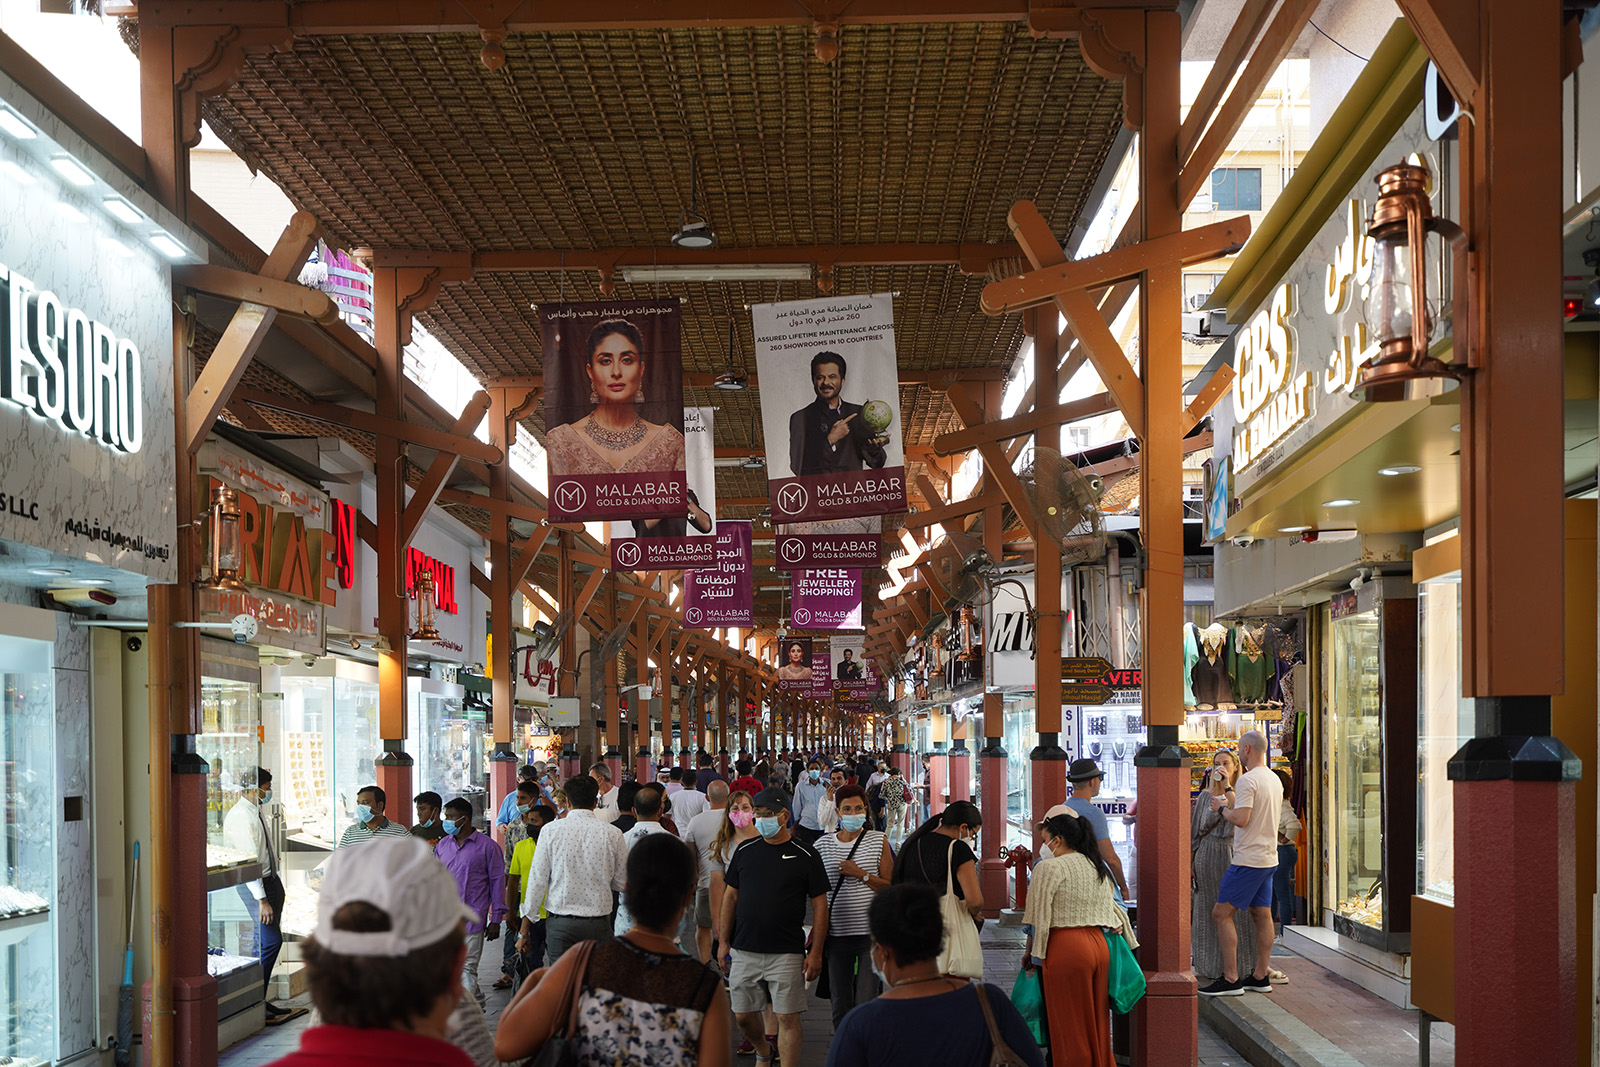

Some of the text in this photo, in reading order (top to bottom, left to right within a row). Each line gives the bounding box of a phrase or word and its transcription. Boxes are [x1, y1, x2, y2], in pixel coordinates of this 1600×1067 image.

[621, 308, 634, 317] من
[635, 306, 673, 315] مجوهرات
[854, 303, 873, 311] ضمان
[577, 310, 599, 318] ذهب
[757, 323, 895, 343] ASSURED LIFETIME MAINTENANCE ACROSS
[783, 339, 828, 350] SHOWROOMS
[846, 333, 884, 344] COUNTRIES
[1233, 284, 1294, 424] GBS
[595, 481, 681, 498] MALABAR
[817, 477, 901, 498] MALABAR
[596, 496, 681, 507] GOLD & DIAMONDS
[818, 491, 902, 507] GOLD & DIAMONDS
[9, 495, 39, 521] LLC
[648, 543, 713, 556] MALABAR
[812, 540, 877, 552] MALABAR
[675, 553, 713, 562] DIAMONDS
[839, 551, 877, 559] DIAMONDS
[805, 568, 849, 579] FREE
[696, 575, 737, 585] المضافة
[797, 579, 856, 588] JEWELLERY
[799, 587, 854, 597] SHOPPING!
[266, 601, 298, 631] GEMS
[706, 609, 750, 617] MALABAR
[815, 610, 858, 618] MALABAR
